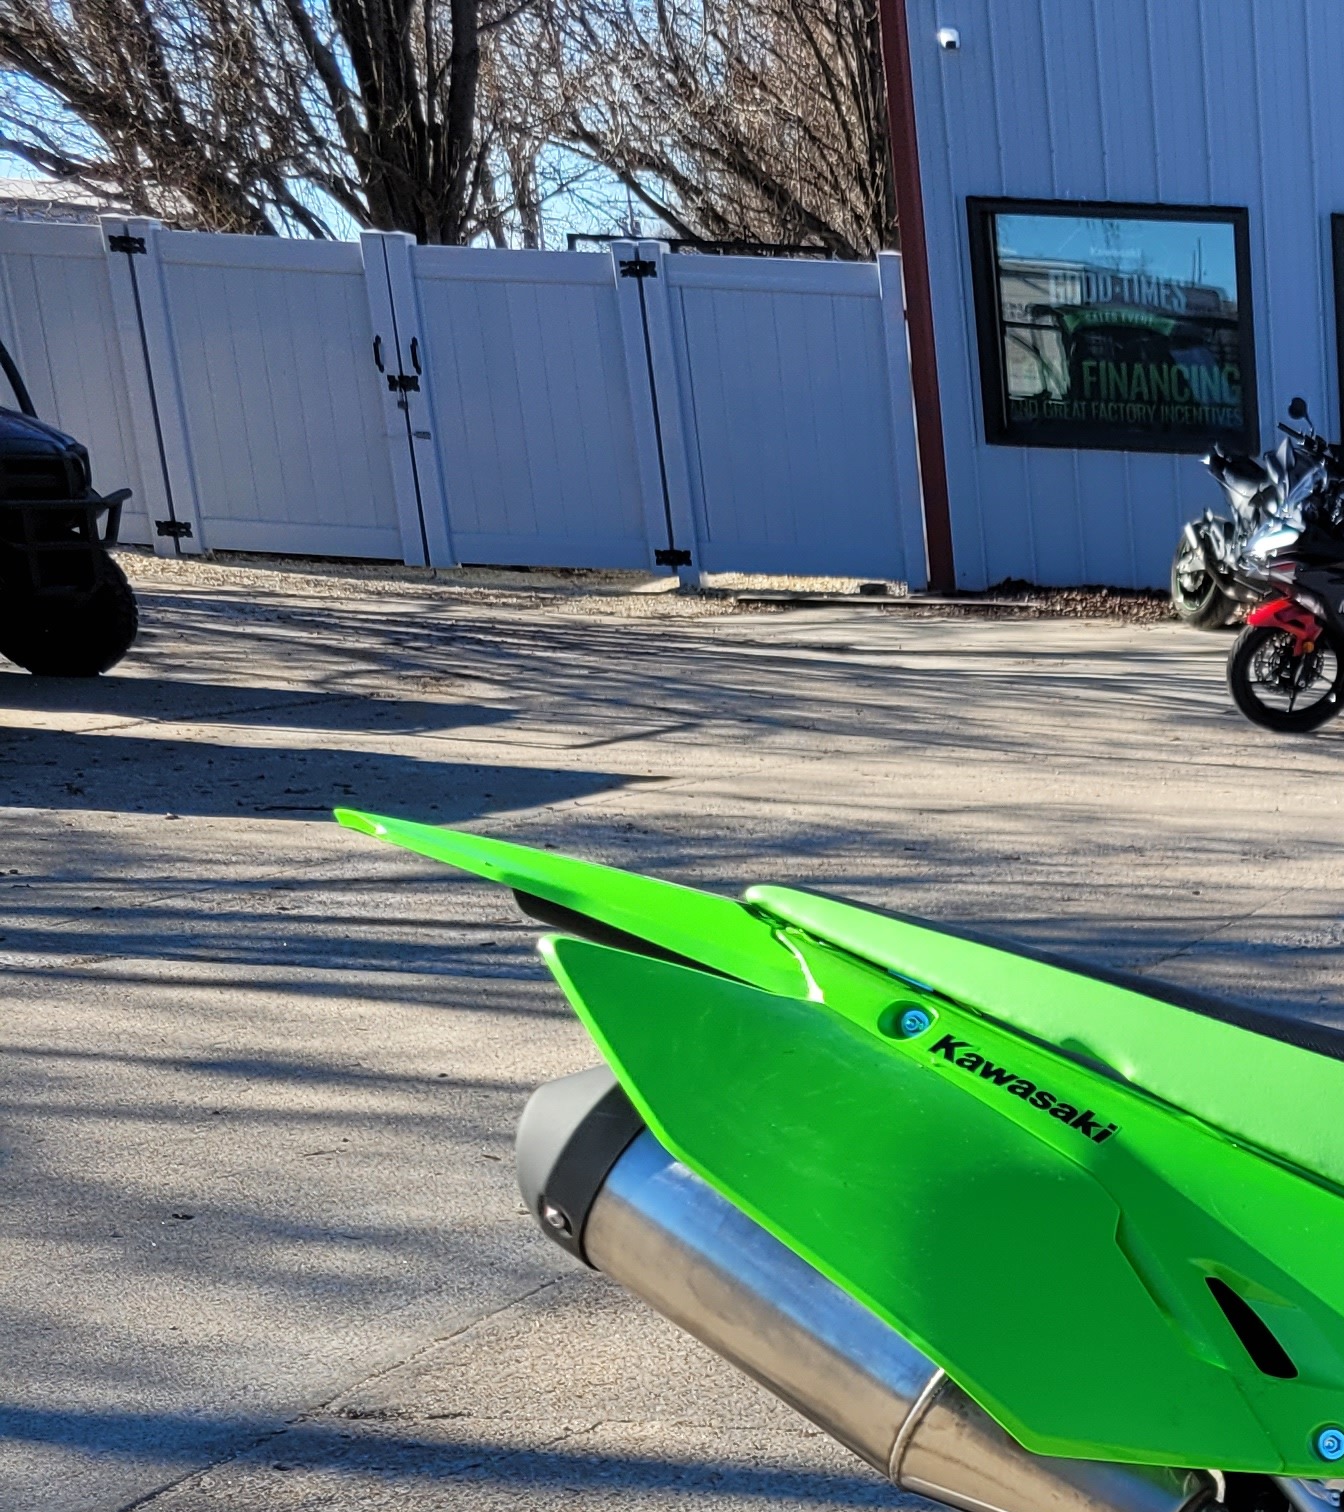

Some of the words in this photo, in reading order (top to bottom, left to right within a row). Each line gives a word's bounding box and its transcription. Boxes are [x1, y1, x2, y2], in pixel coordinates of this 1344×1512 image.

[1083, 361, 1242, 403] FINANCING
[1043, 401, 1087, 421] GREAT
[1092, 402, 1156, 424] FACTORY
[1161, 404, 1244, 427] INCENTIVES
[928, 1033, 1121, 1144] Kawasaki
